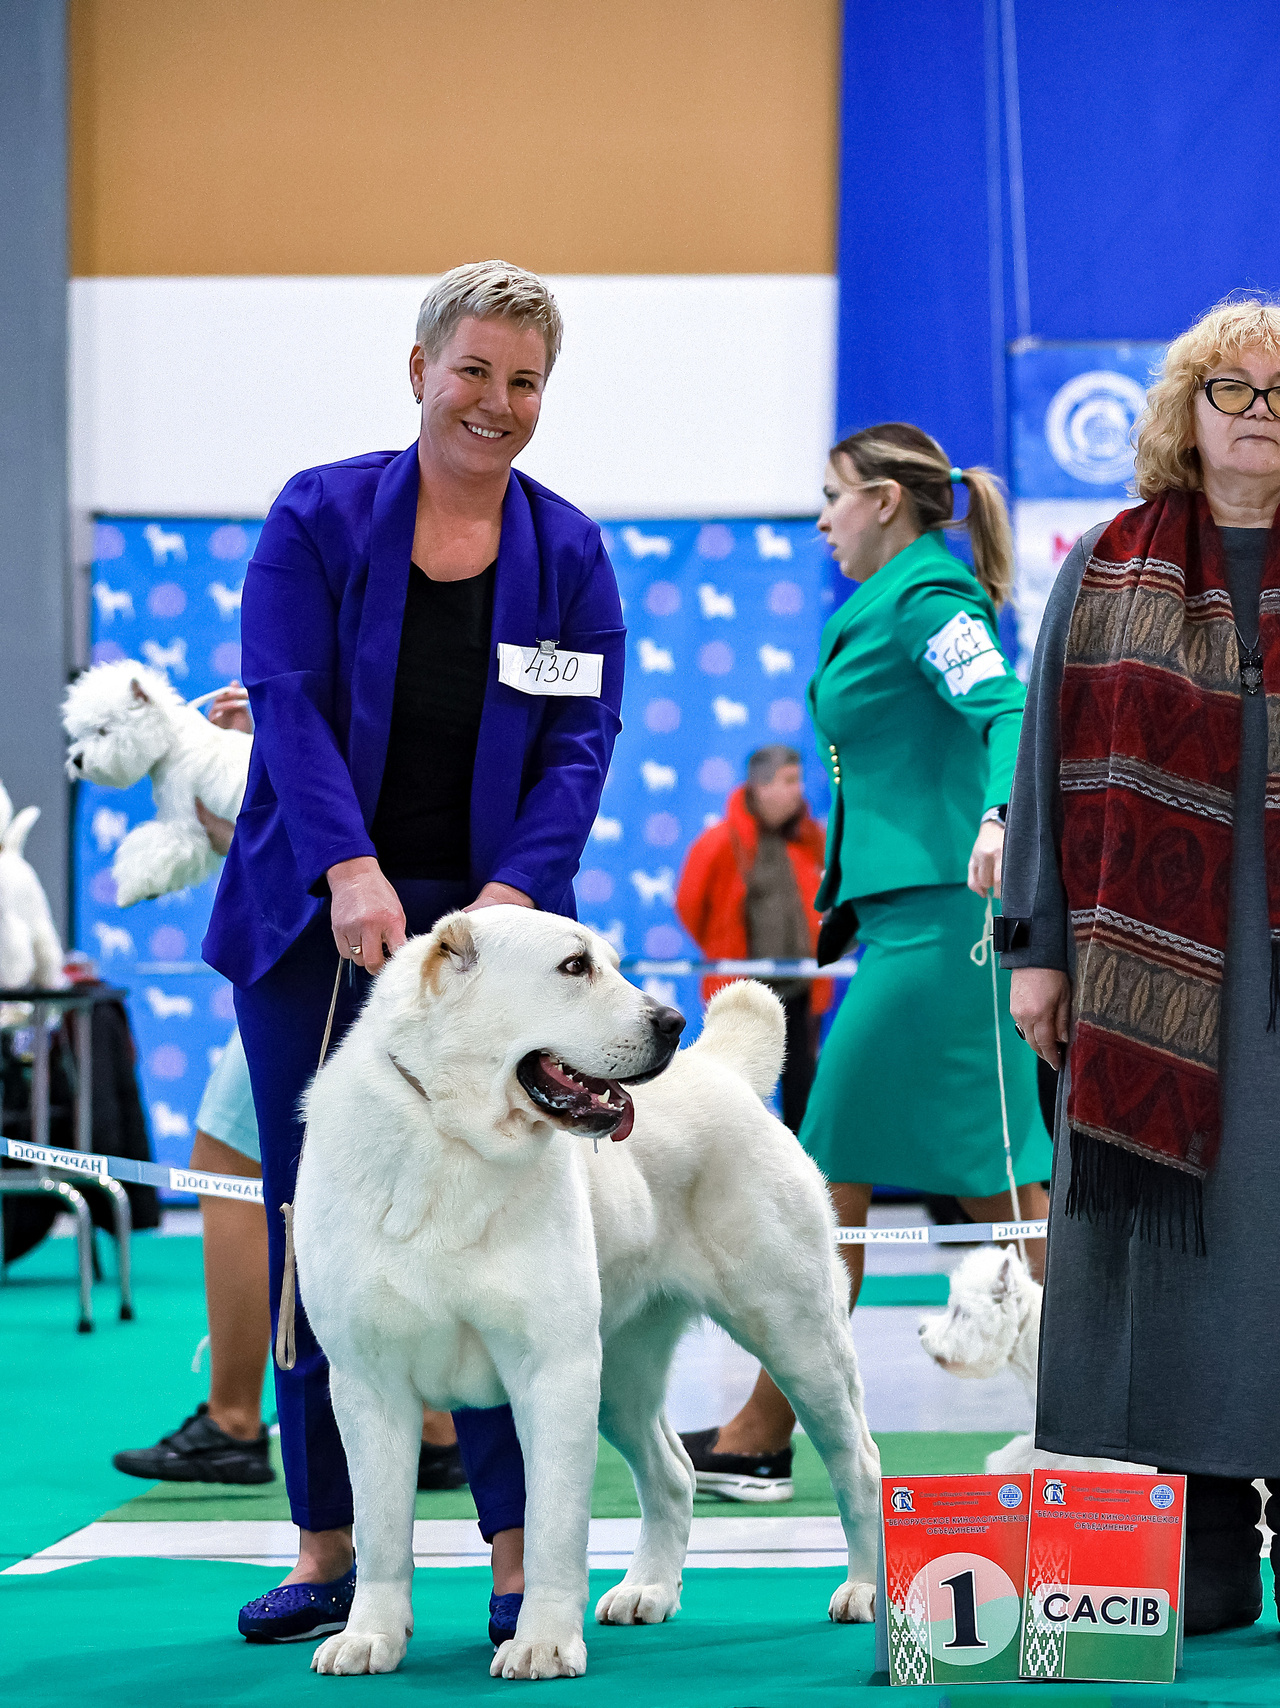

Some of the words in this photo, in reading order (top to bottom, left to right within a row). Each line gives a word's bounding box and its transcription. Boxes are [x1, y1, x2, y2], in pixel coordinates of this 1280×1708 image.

[524, 648, 579, 683] 430
[943, 627, 981, 680] 567
[952, 1514, 1029, 1524] КИНОЛОГИЧЕСКОЕ
[1101, 1512, 1179, 1524] КИНОЛОГИЧЕСКОЕ
[938, 1569, 988, 1649] 1
[1042, 1592, 1161, 1627] CACIB
